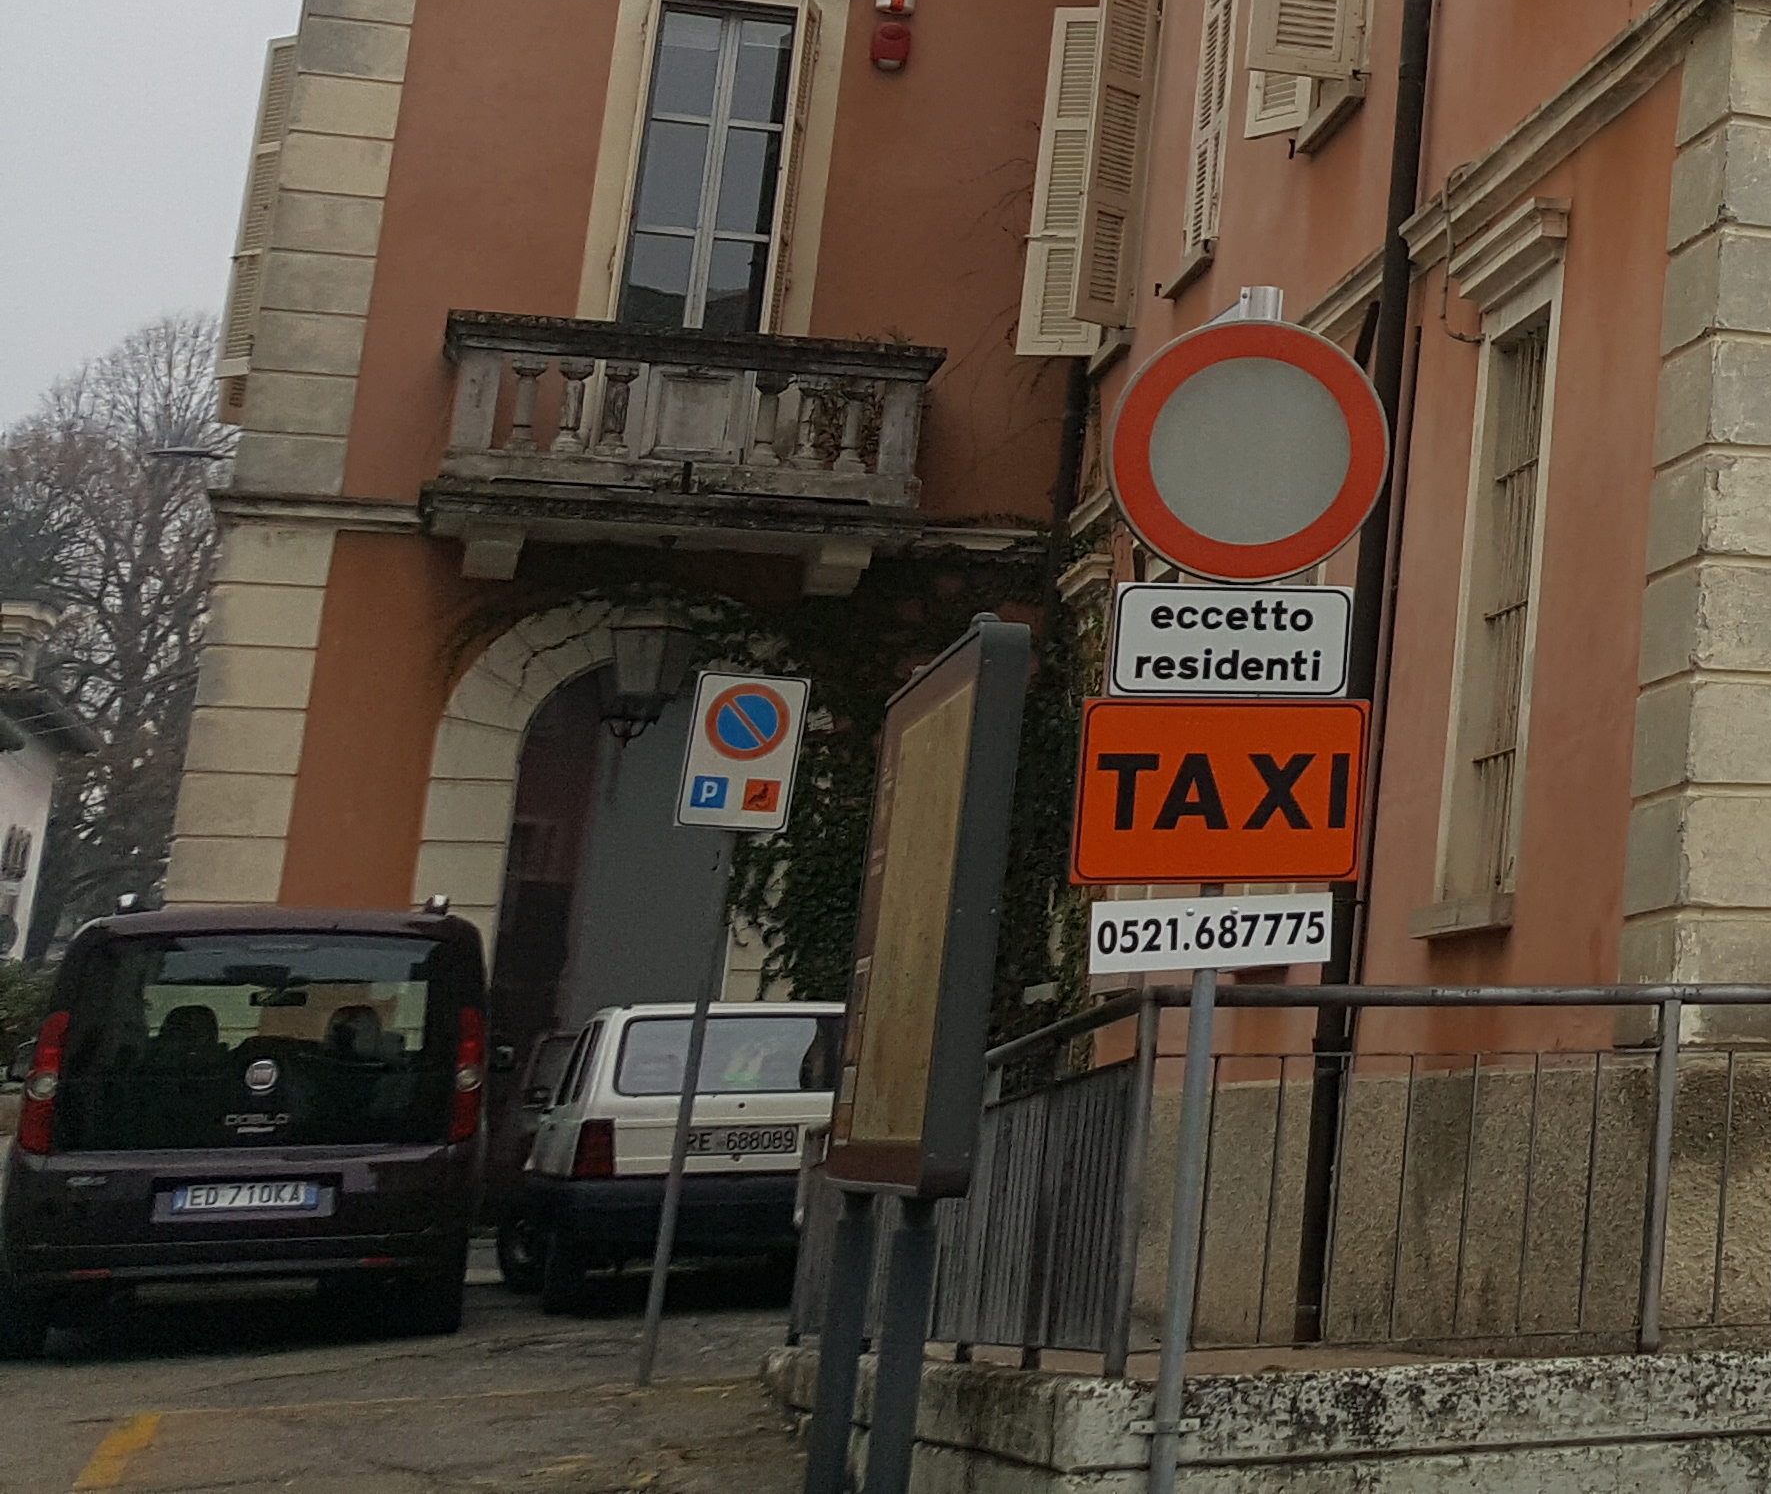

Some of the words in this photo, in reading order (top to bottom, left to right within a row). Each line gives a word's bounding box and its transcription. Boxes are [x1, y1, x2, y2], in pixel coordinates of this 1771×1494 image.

[1150, 599, 1315, 632] eccetto
[1133, 648, 1322, 682] residenti
[699, 780, 719, 803] P
[1096, 752, 1352, 831] TAXI
[1096, 910, 1326, 956] 0521.687775
